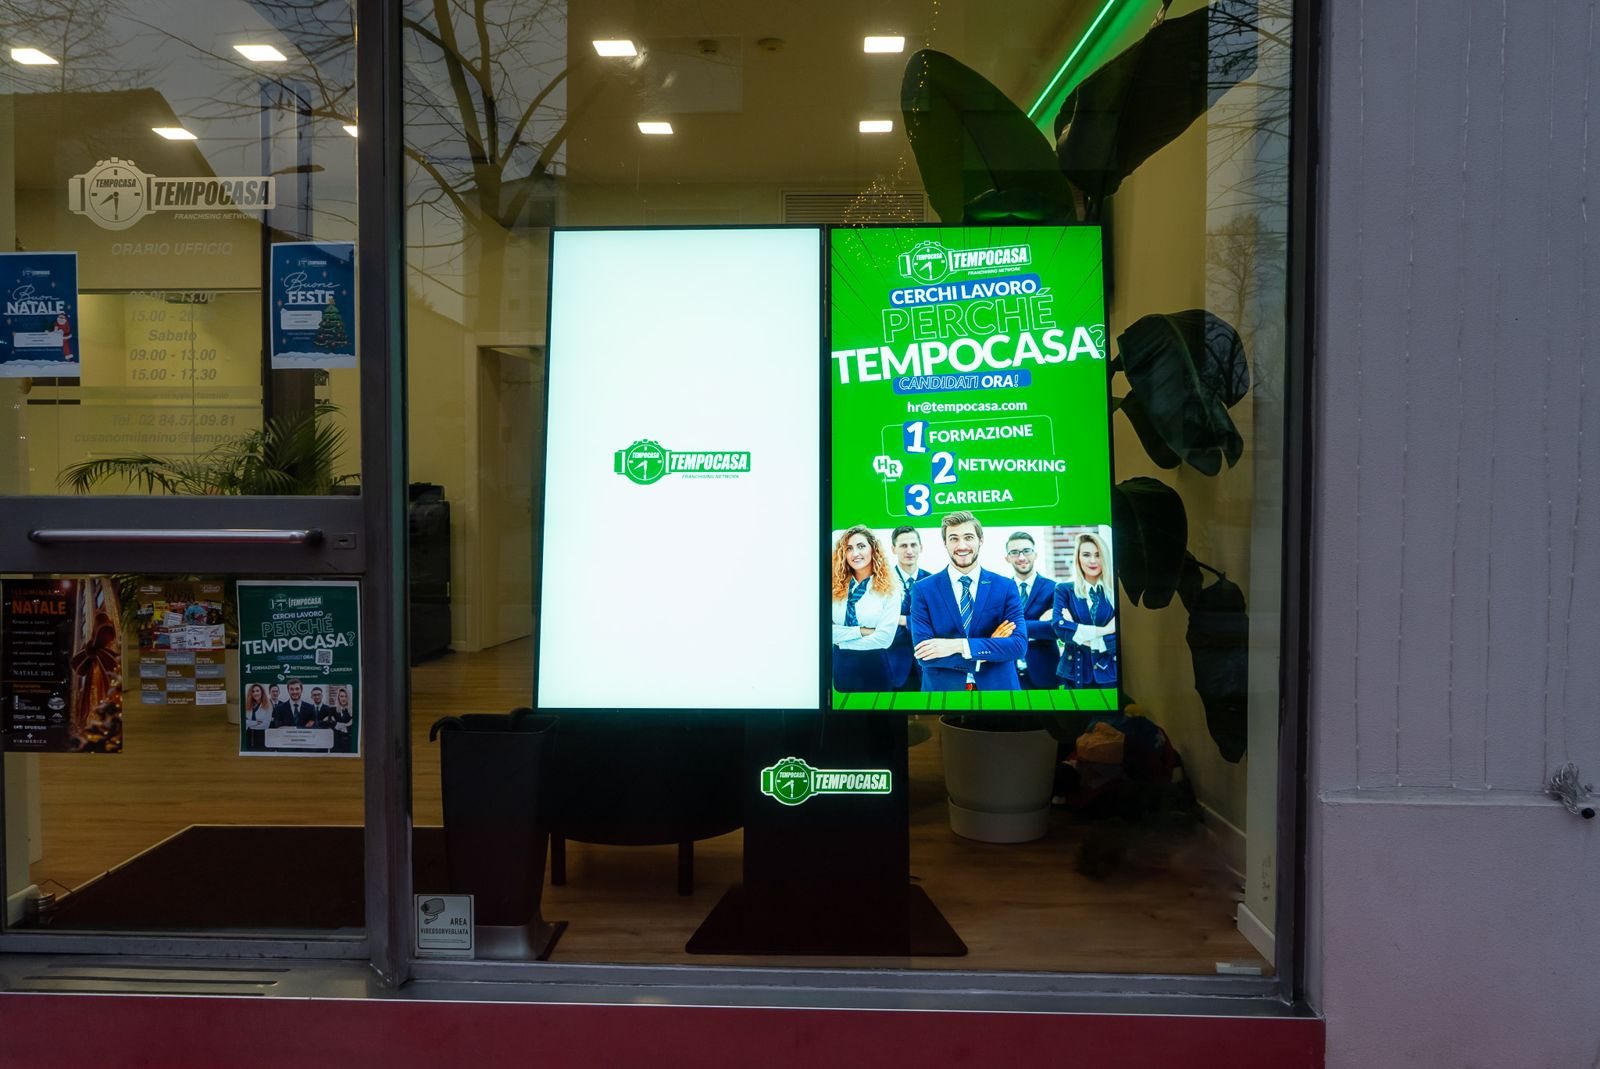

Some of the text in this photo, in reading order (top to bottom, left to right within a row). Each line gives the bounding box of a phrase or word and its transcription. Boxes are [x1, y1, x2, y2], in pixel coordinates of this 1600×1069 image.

[96, 178, 137, 188] TEMPOCASA
[154, 181, 269, 206] TEMPOCASA
[111, 242, 234, 256] ORARIO UFFICIO
[916, 251, 943, 261] TEMPOCASA
[953, 247, 1028, 269] TEMPOCASA
[967, 268, 998, 276] FRANCHISING
[284, 270, 341, 293] Buone
[12, 284, 60, 304] Buon
[181, 291, 216, 302] 13.00
[287, 290, 335, 305] FESTE
[891, 279, 1037, 305] CERCHI LAVORO
[6, 300, 65, 314] NATALE
[130, 310, 166, 322] 15.00
[881, 287, 1057, 343] PERCHÉ
[147, 329, 197, 341] Sabato
[129, 349, 167, 361] 09.00
[180, 349, 217, 361] 13.00
[831, 324, 1107, 385] TEMPOCASA?
[130, 368, 167, 380] 15.00
[180, 368, 217, 380] 17.30
[898, 374, 1019, 390] CANDIDATI ORA!
[907, 401, 1028, 414] hr@tempocasa.com
[138, 414, 155, 427] 02
[906, 421, 1034, 454] 1 FORMAZIONE
[632, 451, 660, 459] TEMPOCASA
[670, 453, 749, 471] TEMPOCASA
[877, 458, 898, 475] HR
[931, 452, 1066, 485] 2 NETWORKING
[906, 484, 1014, 517] 3 CARRIERA
[12, 600, 67, 615] NATALE
[272, 610, 324, 620] CERCHI LAVORO
[261, 613, 335, 638] PERCHÉ
[245, 663, 252, 674] 1
[283, 663, 292, 675] 2
[322, 665, 330, 675] 3
[779, 771, 806, 779] TEMPOCASA
[815, 774, 887, 790] TEMPOCASA
[450, 917, 467, 926] AREA
[420, 927, 469, 935] VIDEOSORVEGLIATA
